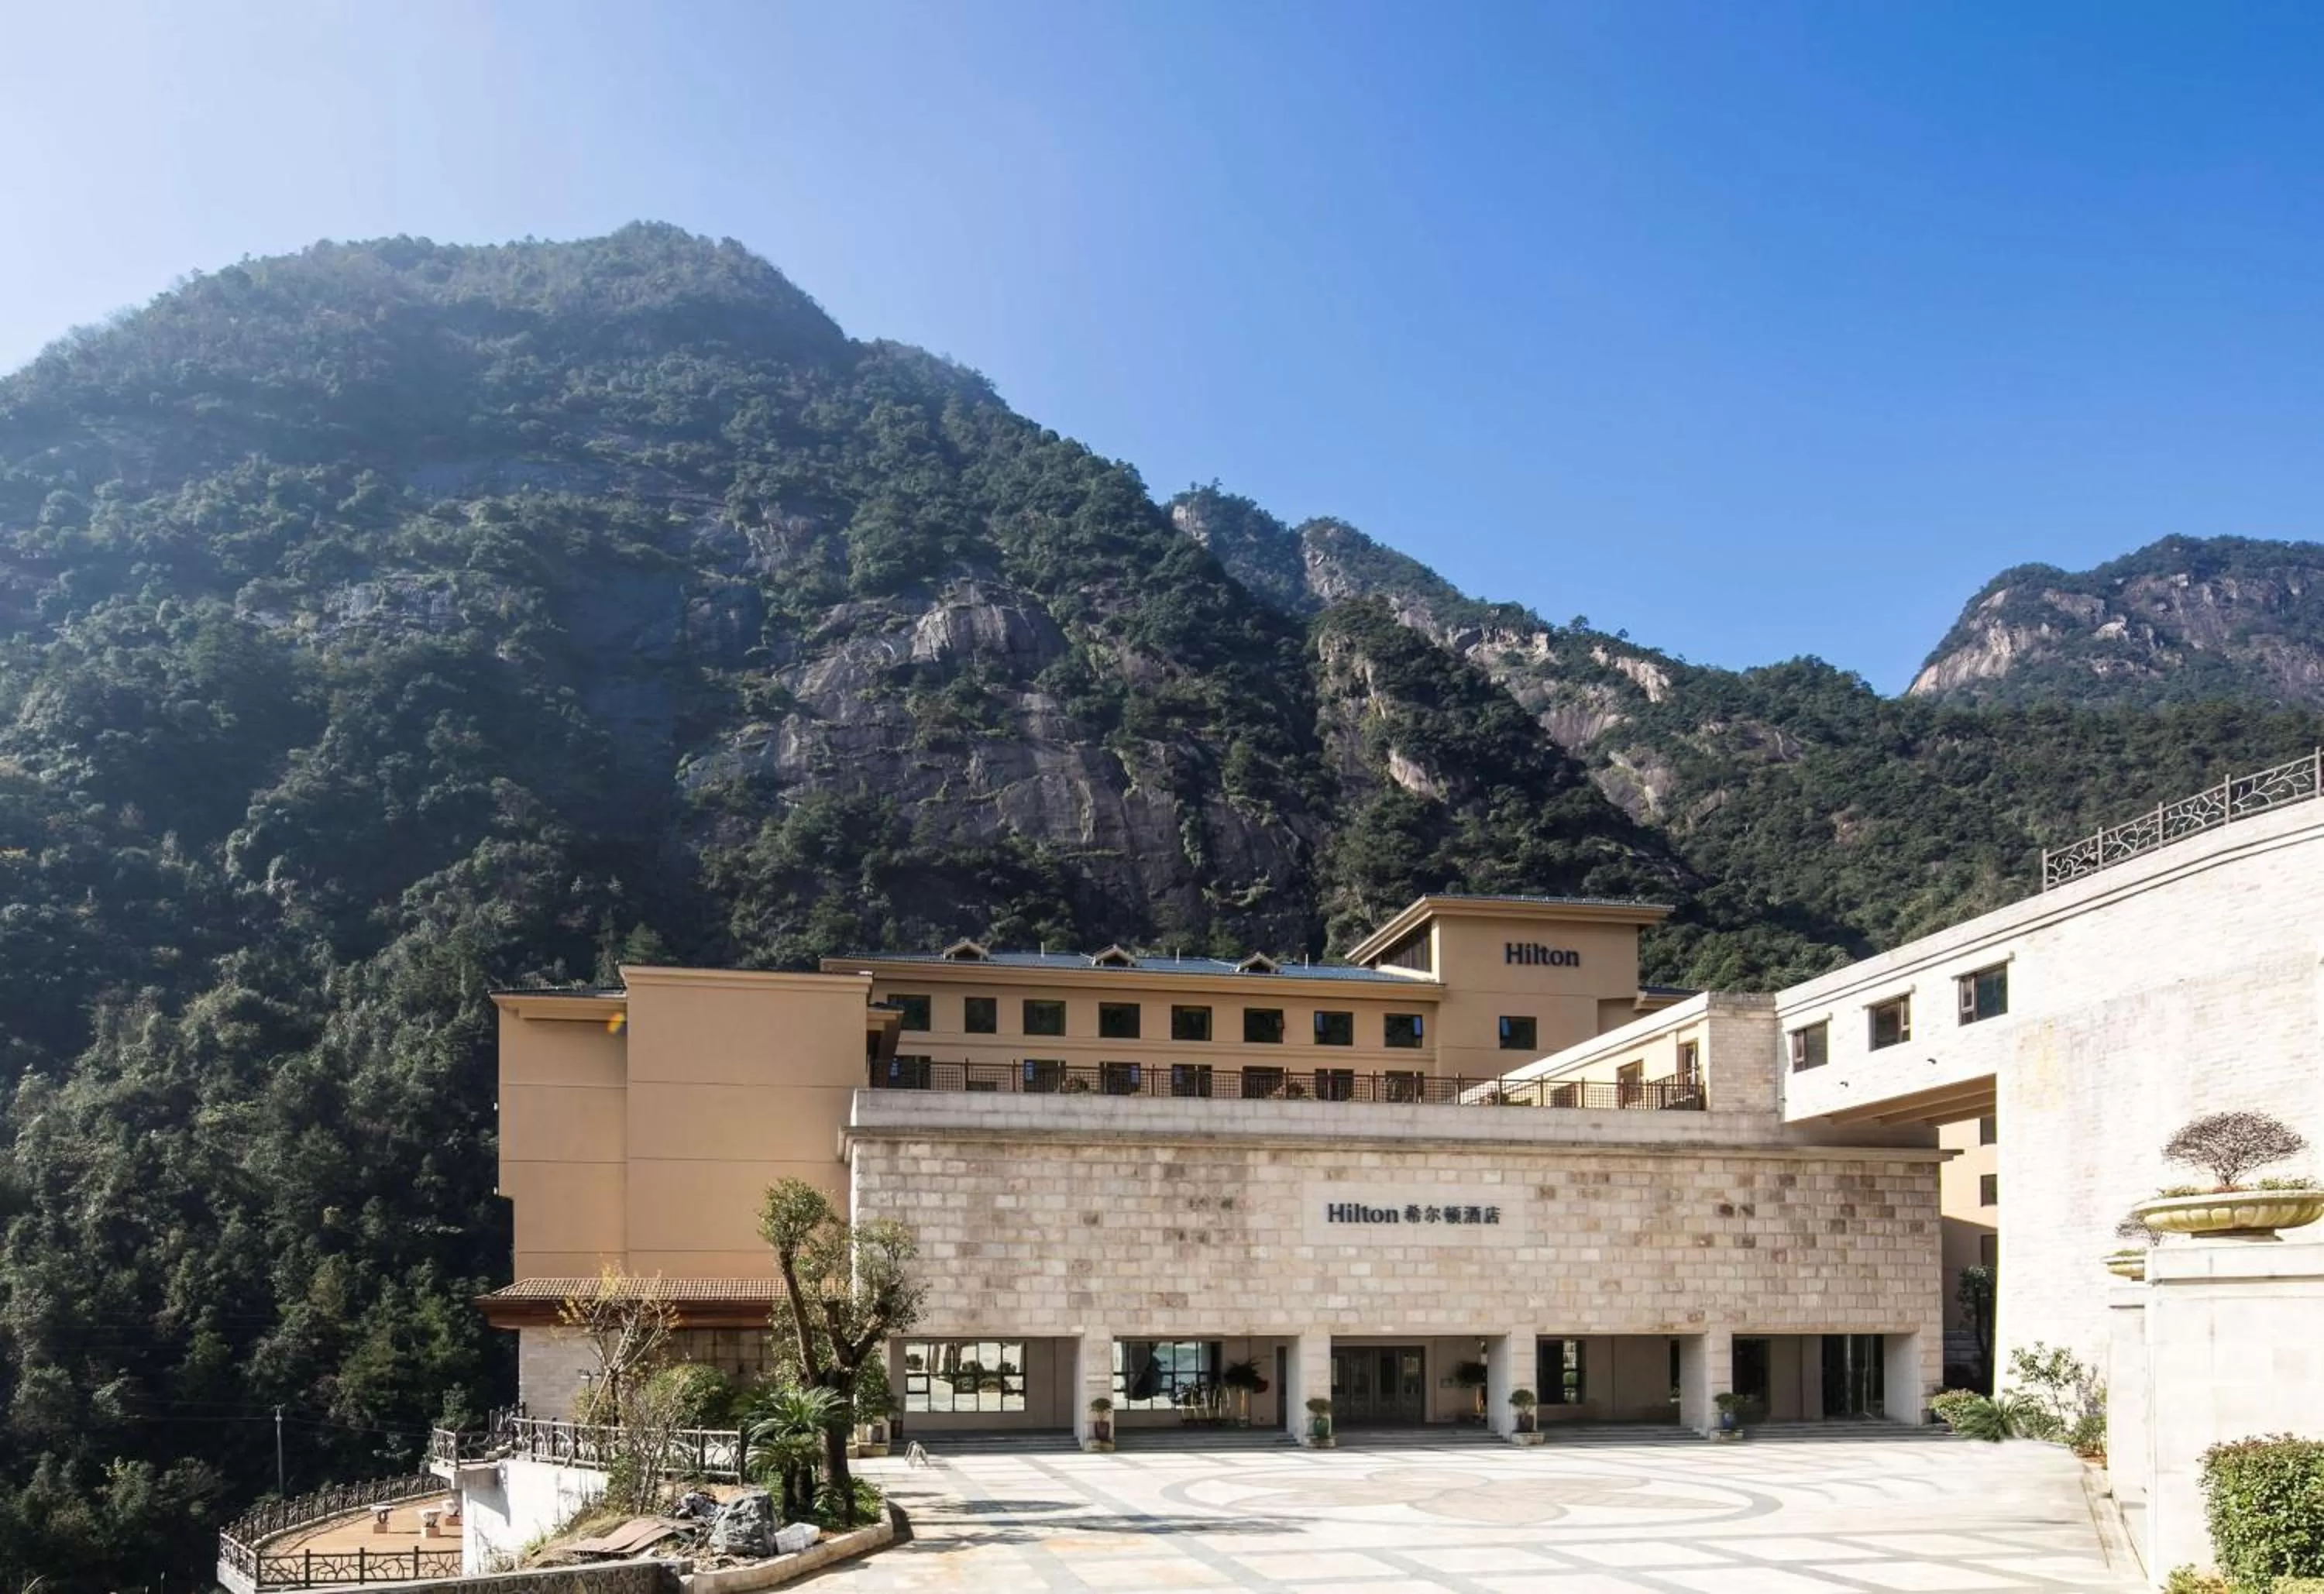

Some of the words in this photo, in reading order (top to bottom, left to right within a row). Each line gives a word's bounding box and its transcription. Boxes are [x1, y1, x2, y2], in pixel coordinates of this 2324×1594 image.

[1505, 943, 1580, 967] Hilton
[1328, 1203, 1399, 1223] Hilton
[1404, 1204, 1501, 1225] 希尔顿酒店
